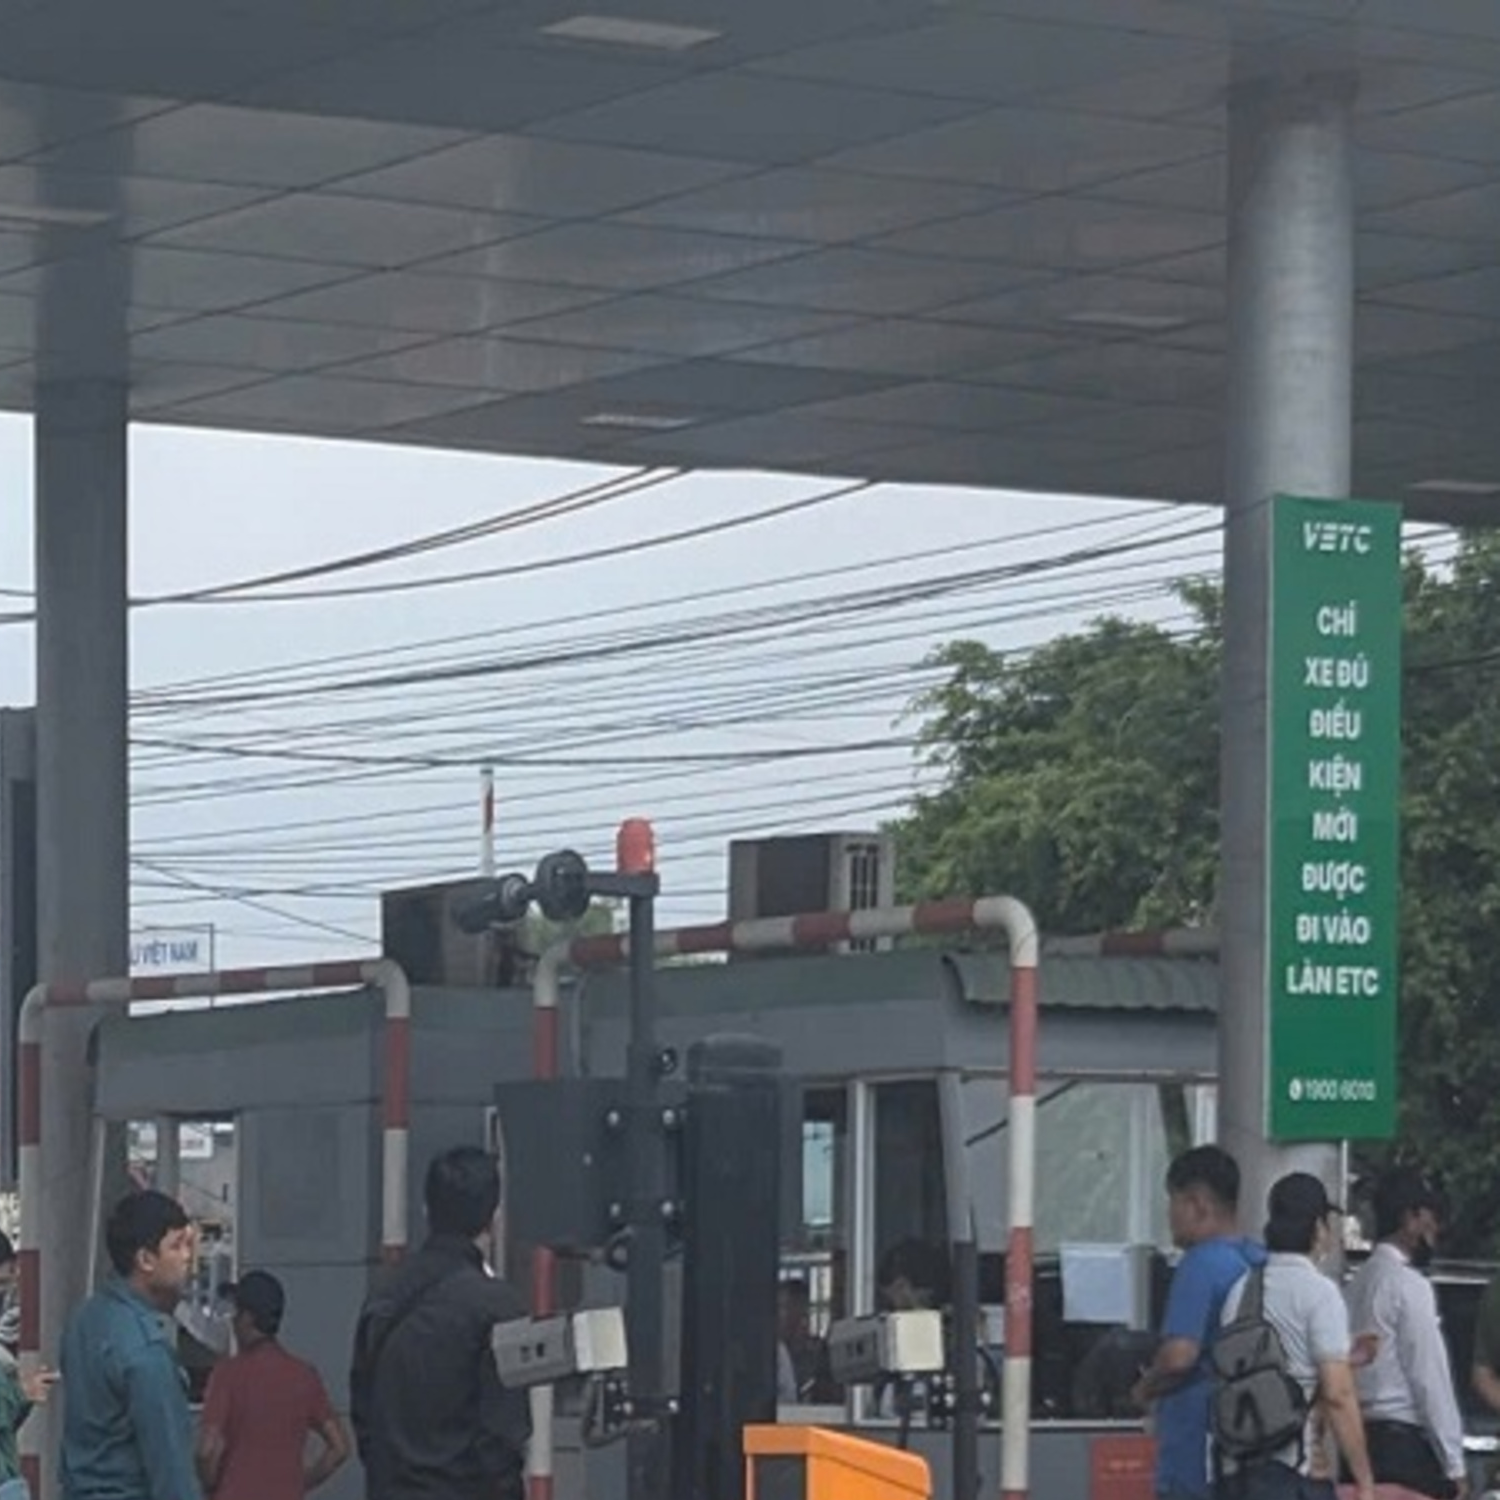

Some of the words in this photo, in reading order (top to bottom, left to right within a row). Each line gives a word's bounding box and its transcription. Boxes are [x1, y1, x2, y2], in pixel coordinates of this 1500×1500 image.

[1303, 521, 1372, 554] VETC
[1304, 656, 1334, 688] XE
[1308, 753, 1362, 798] KIỆN
[1312, 805, 1358, 843] MỚI
[1302, 862, 1367, 900] ĐƯỢC
[1296, 913, 1320, 943] ĐI
[1322, 907, 1371, 945] VÀO
[1286, 958, 1333, 996] LÀN
[1335, 965, 1380, 996] ETC
